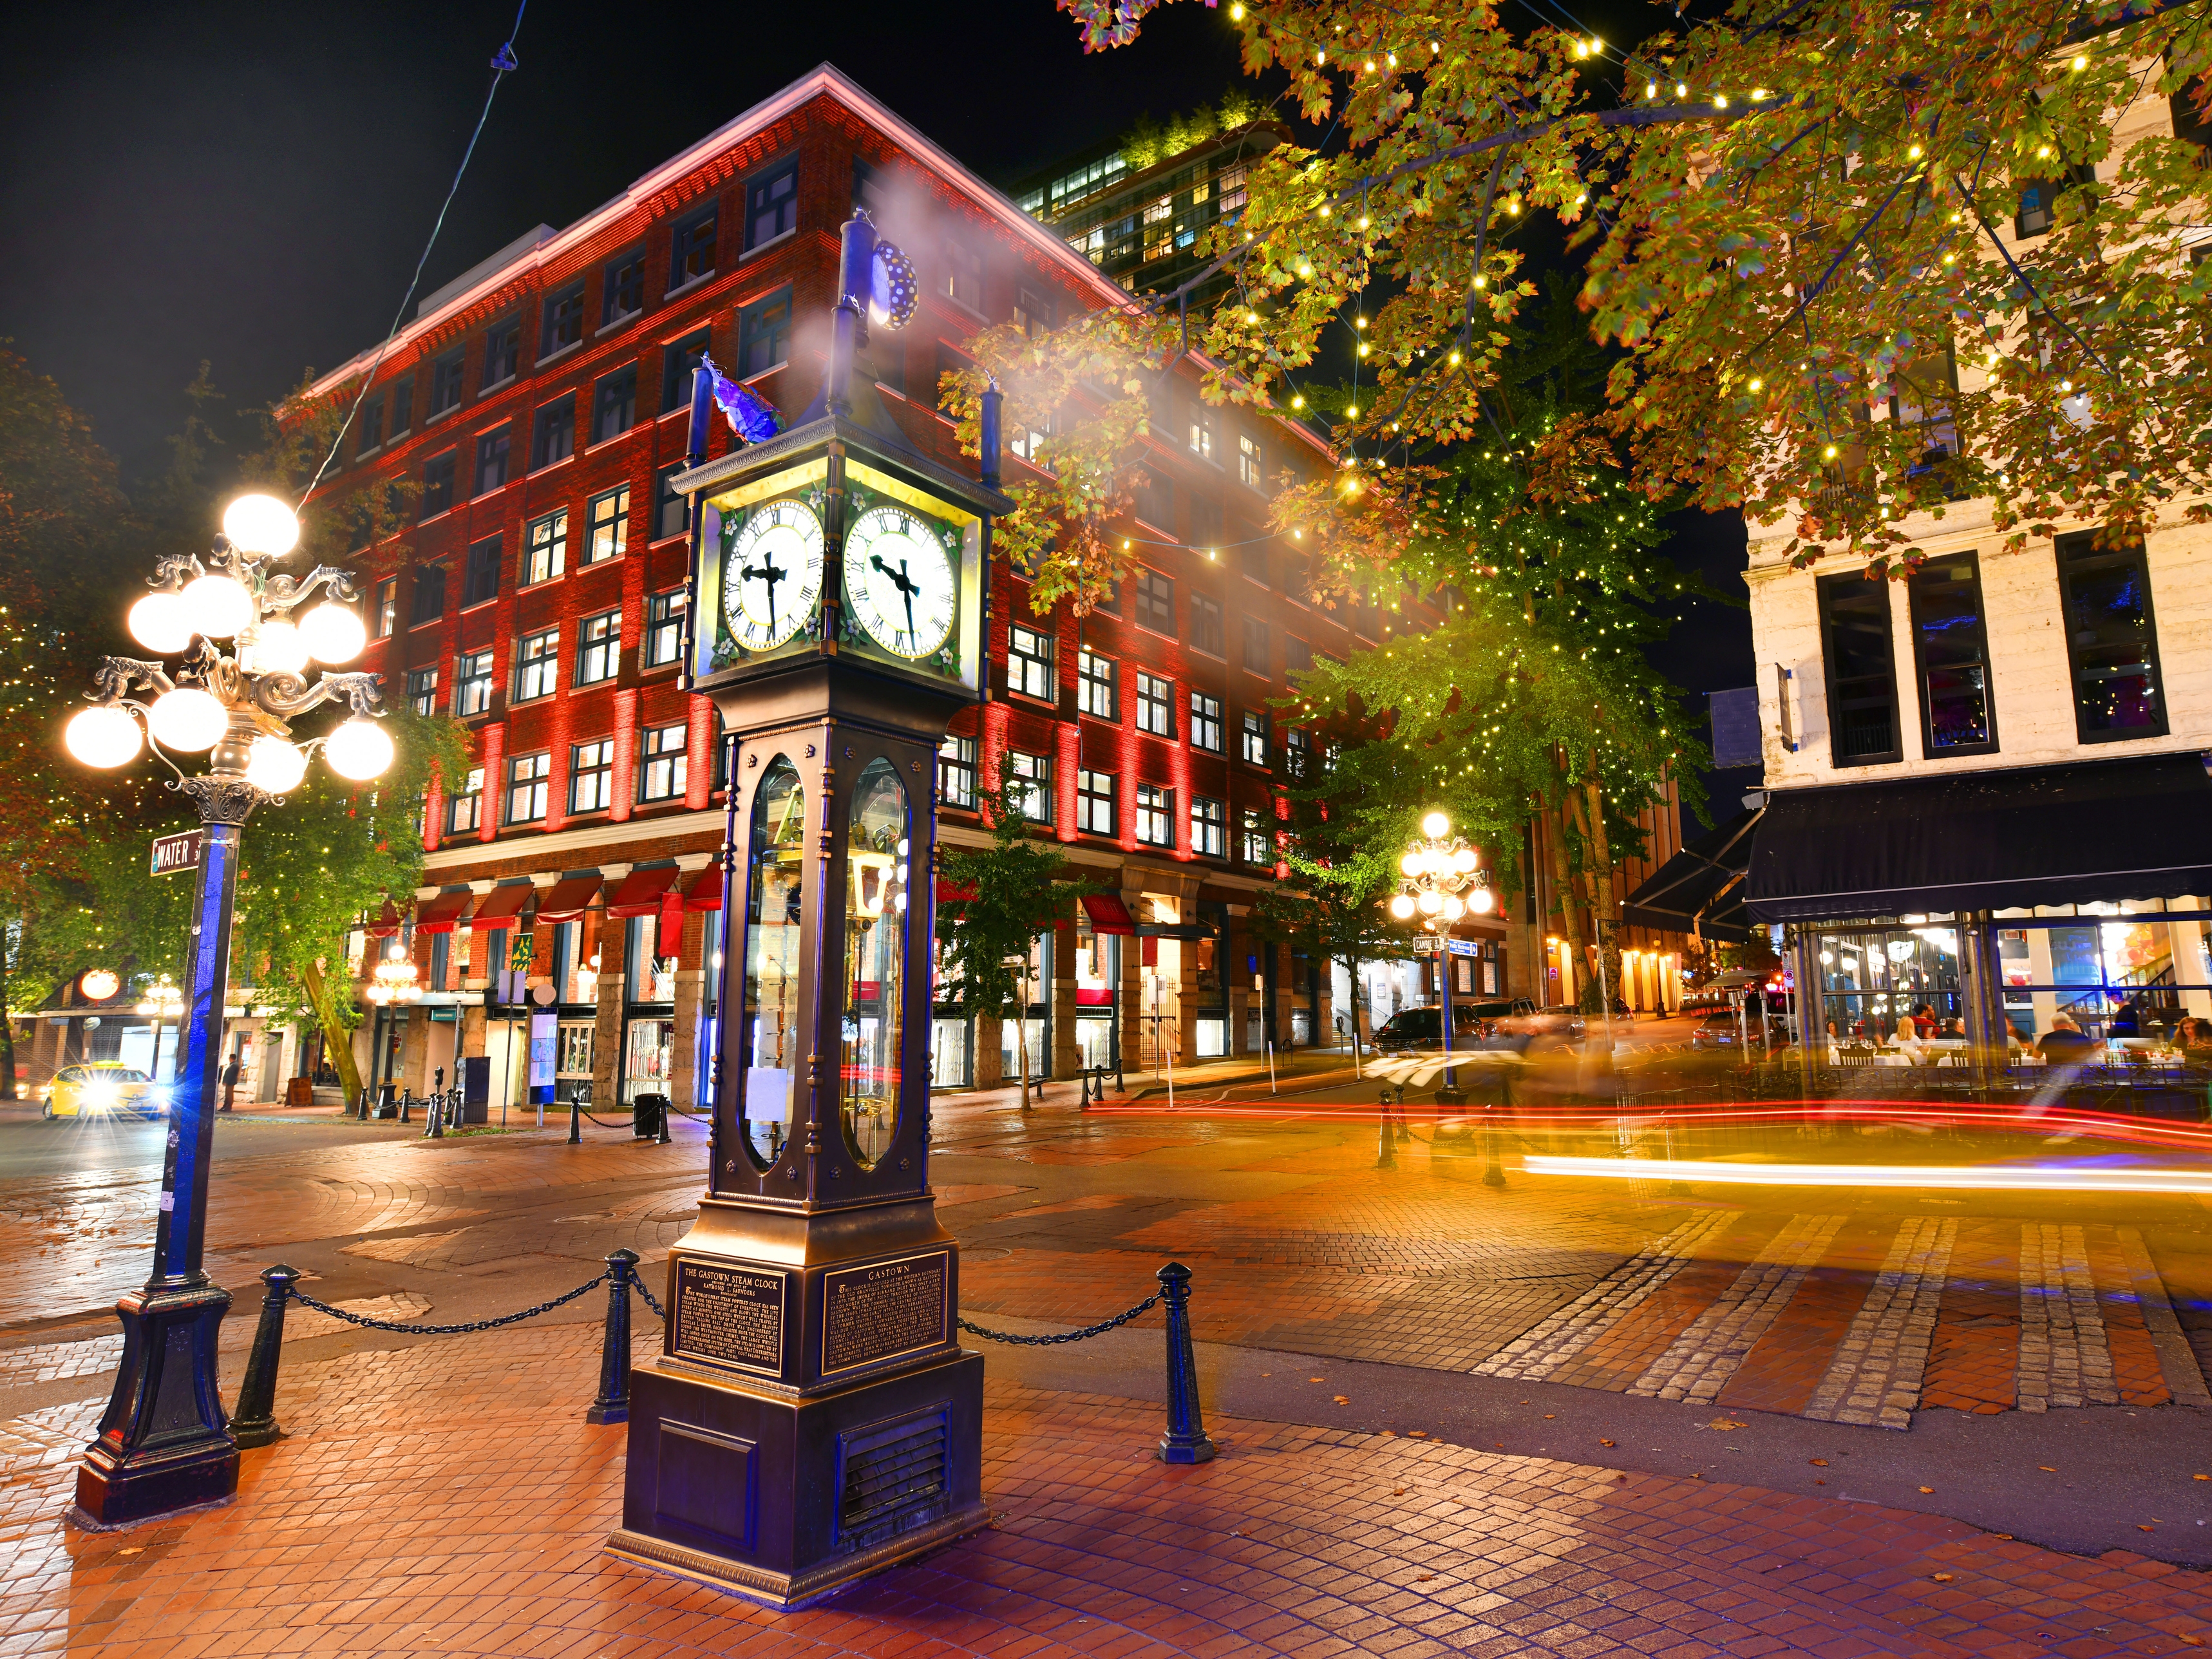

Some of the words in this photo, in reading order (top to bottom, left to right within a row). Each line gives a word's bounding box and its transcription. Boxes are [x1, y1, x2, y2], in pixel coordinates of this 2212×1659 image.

[157, 840, 189, 867] WATER
[1092, 901, 1119, 913] INUIT
[1417, 940, 1433, 949] CAMBIE
[685, 1268, 697, 1276] THE
[699, 1270, 730, 1282] GASTOWN
[732, 1275, 753, 1286] STEAM
[754, 1278, 778, 1290] CLOCK
[869, 1266, 909, 1280] GASTOWN
[733, 1288, 755, 1296] SAUNDERS
